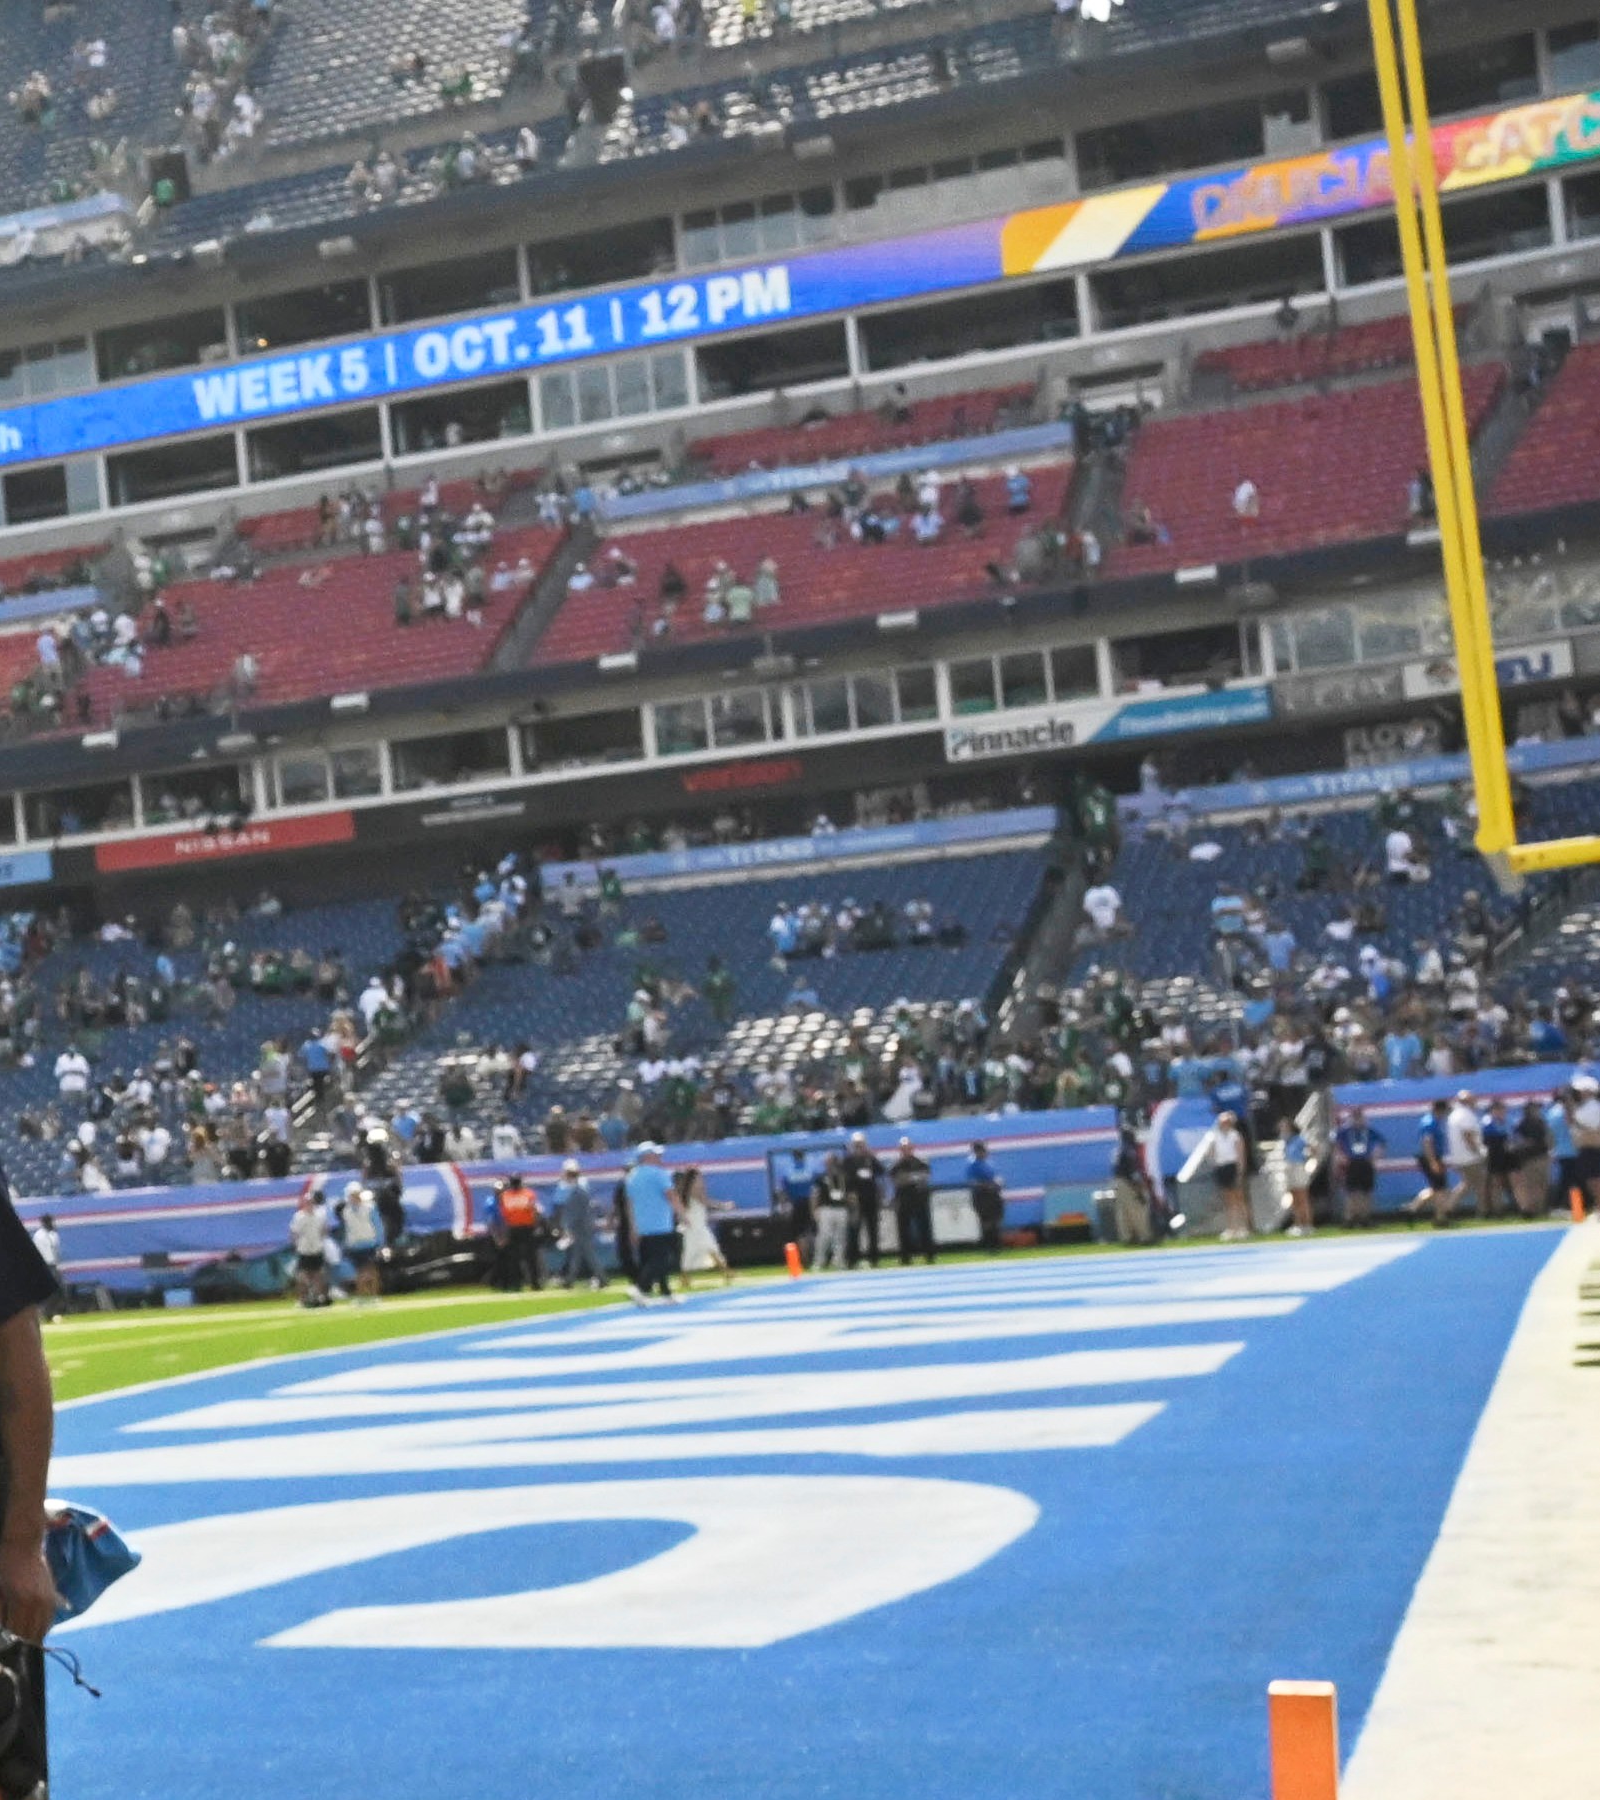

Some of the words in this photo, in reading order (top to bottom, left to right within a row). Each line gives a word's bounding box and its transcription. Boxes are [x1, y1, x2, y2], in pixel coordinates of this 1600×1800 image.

[193, 348, 335, 420] WEEK
[341, 347, 369, 393] 5
[411, 318, 530, 378] OCT.
[533, 304, 594, 350] 11
[640, 286, 700, 336] 12
[704, 266, 792, 324] PM
[949, 717, 1076, 759] Pinnacle
[174, 828, 271, 856] NISSAN
